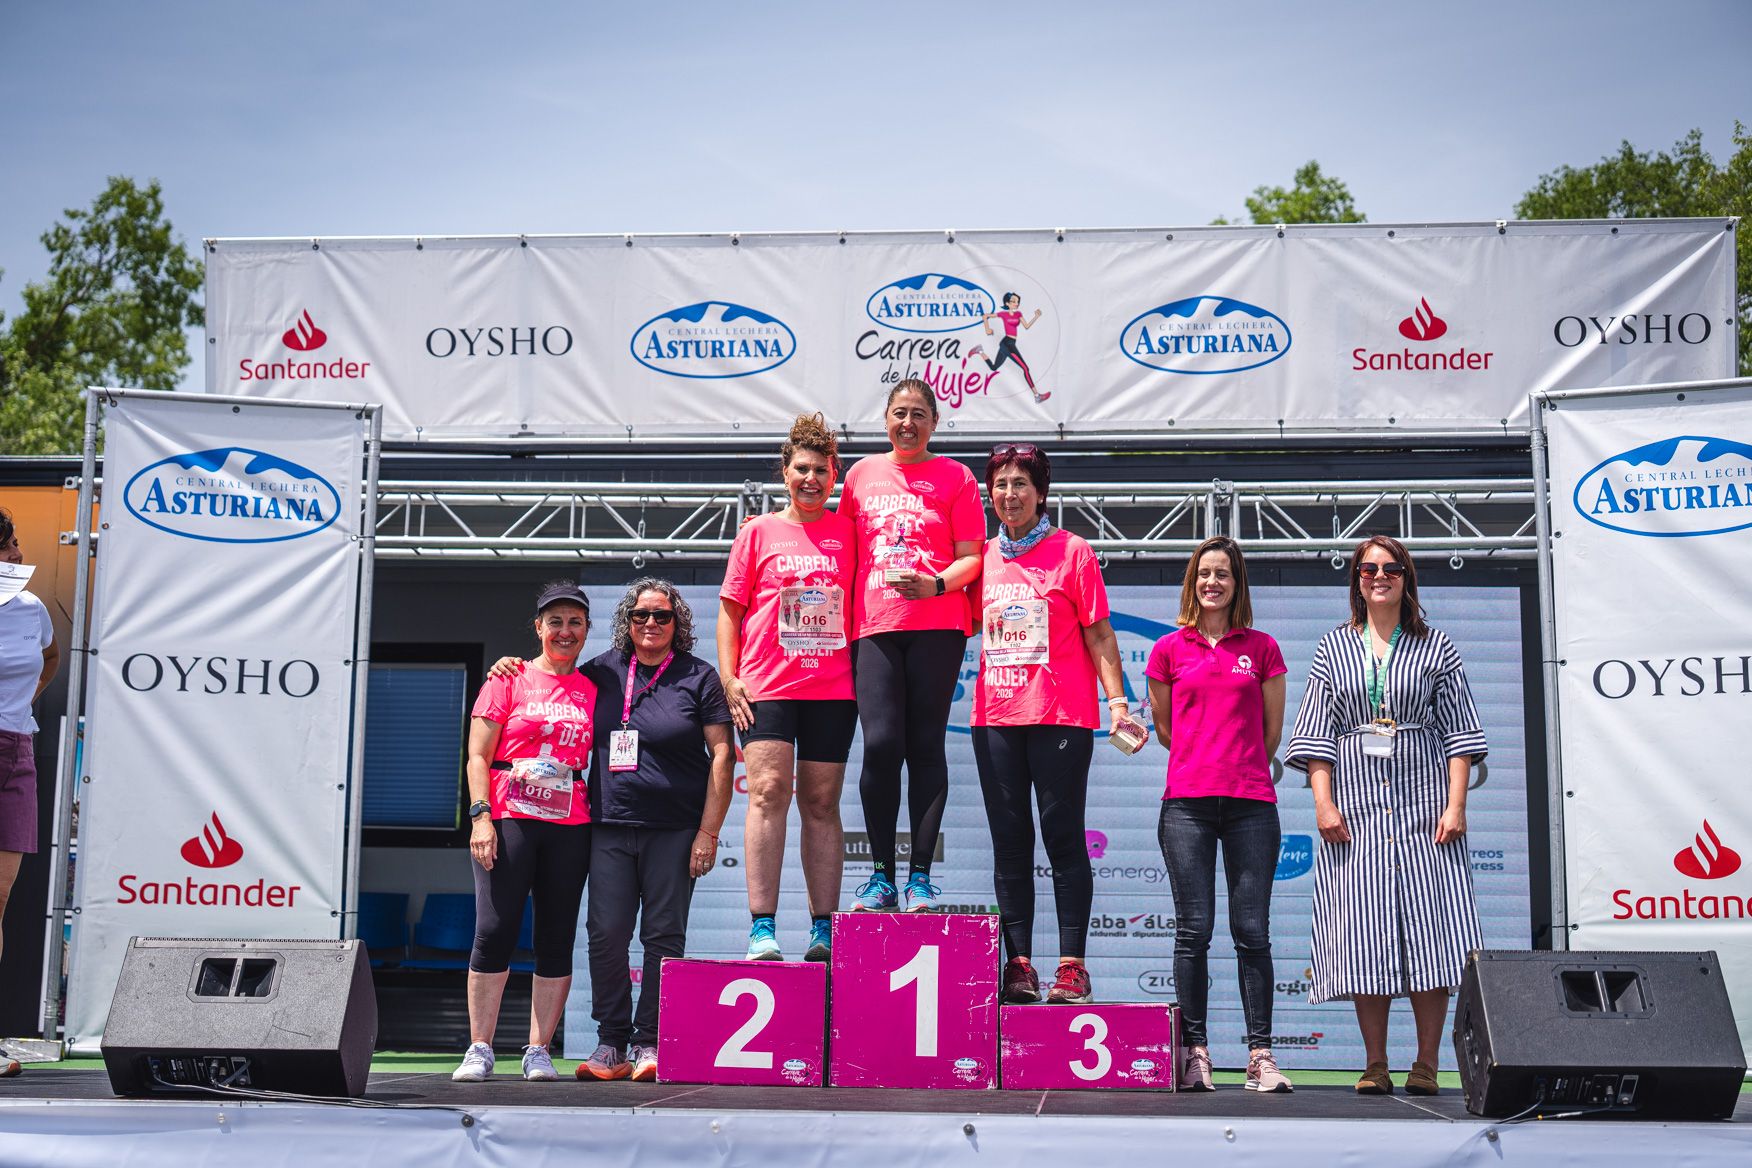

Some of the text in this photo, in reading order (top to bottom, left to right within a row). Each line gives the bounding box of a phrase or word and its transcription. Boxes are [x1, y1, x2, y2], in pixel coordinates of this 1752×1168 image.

[876, 295, 985, 318] ASTURIANA
[668, 326, 779, 336] CENTRAL LECHERA
[1159, 321, 1274, 332] CENTRAL LECHERA
[1554, 312, 1712, 347] OYSHO
[425, 325, 573, 358] OYSHO
[643, 330, 783, 360] ASTURIANA
[856, 330, 961, 360] Carrera
[1133, 325, 1279, 357] ASTURIANA
[239, 357, 370, 381] Santander
[1352, 348, 1493, 371] Santander
[881, 363, 919, 384] de la
[923, 358, 1000, 409] Mujer
[175, 476, 319, 494] CENTRAL LECHERA
[1625, 466, 1752, 483] CENTRAL LECH
[139, 477, 325, 522] ASTURIANA
[864, 494, 925, 511] CARRERA
[1591, 477, 1752, 515] ASTURIA
[770, 540, 798, 550] OYSHO
[776, 555, 839, 573] CARRERA
[983, 583, 1035, 600] CARRERA
[802, 615, 827, 625] 016
[1004, 630, 1027, 641] 016
[121, 652, 320, 698] OYSHO
[800, 658, 819, 669] 2026
[984, 668, 1029, 687] MUJER
[1593, 656, 1752, 699] OYSH
[525, 688, 552, 696] OYSHO
[995, 688, 1014, 699] 2026
[525, 701, 590, 723] CARRERA
[558, 722, 580, 748] DE
[525, 784, 553, 799] 016
[117, 875, 301, 907] Santander
[1612, 888, 1752, 920] Santan
[889, 945, 939, 1057] 1
[714, 978, 775, 1069] 2
[1068, 1013, 1112, 1081] 3
[1271, 1036, 1318, 1045] ORREO
